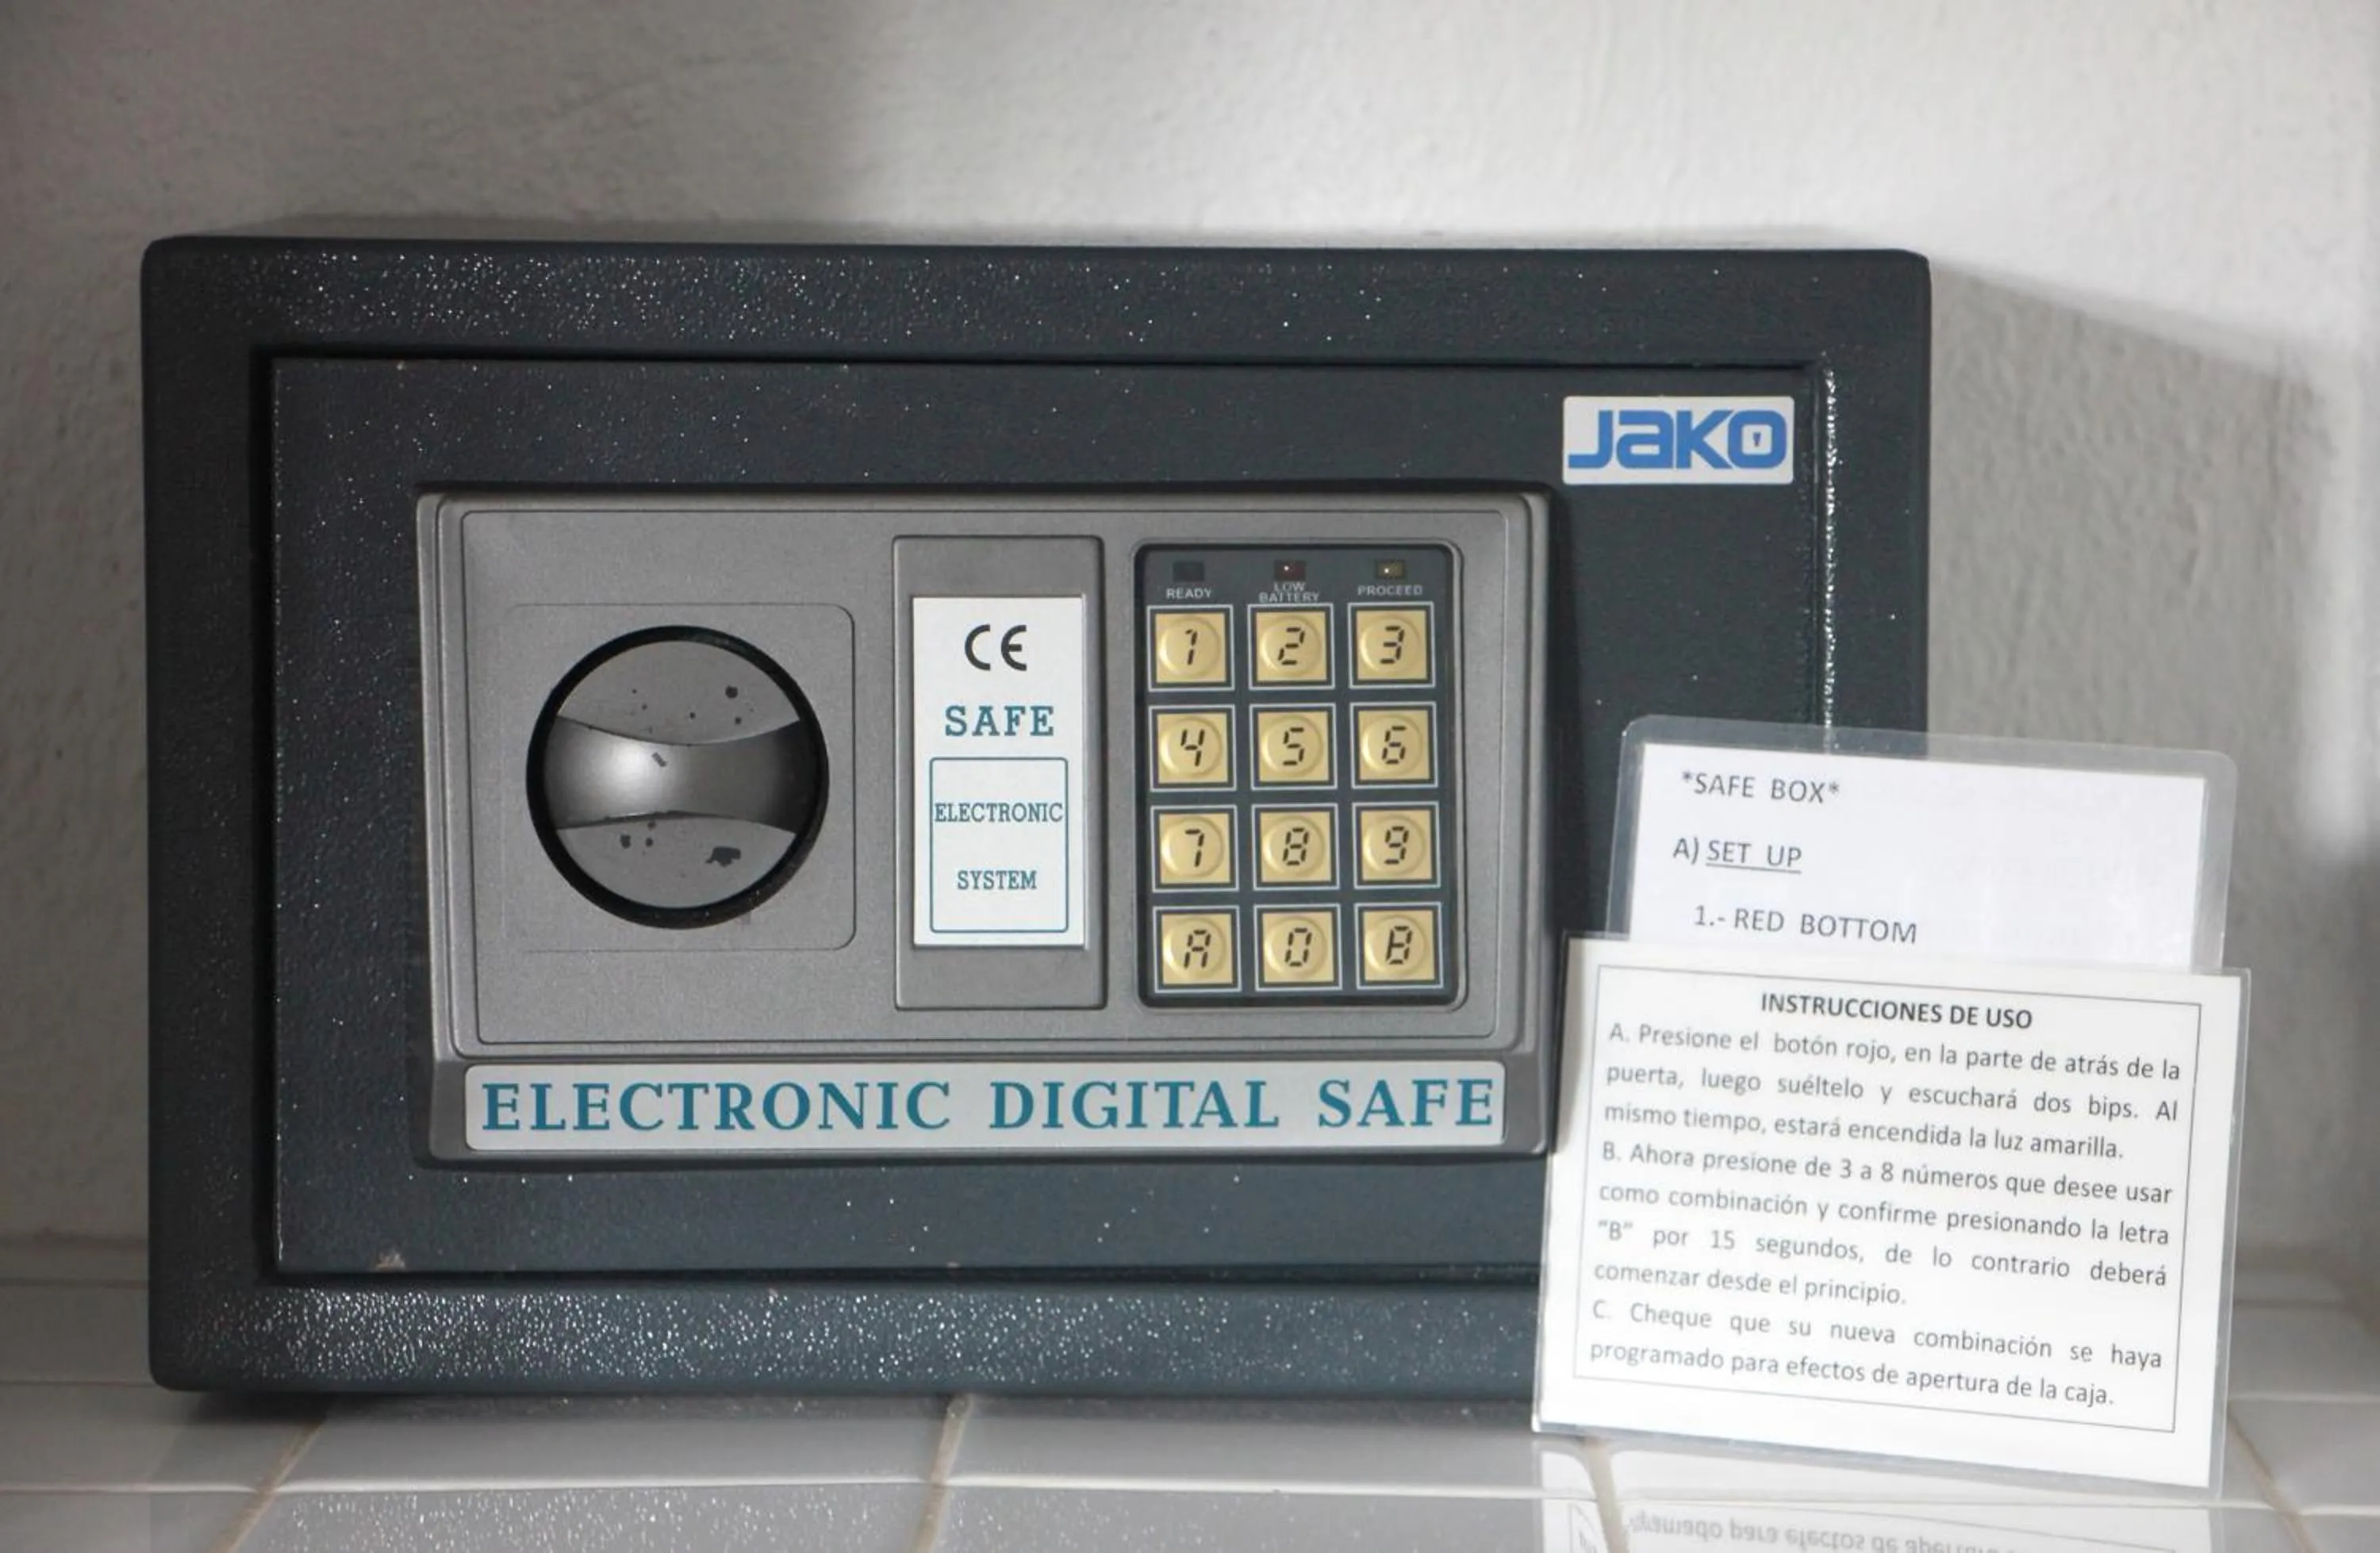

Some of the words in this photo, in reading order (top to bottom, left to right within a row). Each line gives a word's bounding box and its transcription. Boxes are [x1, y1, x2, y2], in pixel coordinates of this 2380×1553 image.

[1165, 588, 1212, 600] READY
[1258, 592, 1320, 603] BATTERY
[1273, 582, 1306, 592] LOW
[1357, 585, 1423, 596] PROCEED
[1184, 628, 1199, 666] 1
[1277, 627, 1306, 666] 2
[1379, 625, 1406, 665] 3
[944, 704, 1054, 737] SAFE
[1180, 728, 1206, 767] 4
[1281, 727, 1305, 766] 5
[1381, 725, 1407, 765] 6
[935, 802, 1063, 823] ELECTRONIC
[1184, 829, 1205, 868] 7
[1282, 827, 1310, 866] 8
[1384, 826, 1410, 865] 9
[1672, 837, 1700, 865] A)
[1706, 839, 1752, 865] SET
[1766, 845, 1802, 868] UP
[957, 869, 1038, 890] SYSTEM
[1734, 907, 1785, 933] RED
[1799, 913, 1917, 944] BOTTOM
[1760, 993, 1943, 1023] INSTRUCCIONES
[1948, 1004, 1980, 1026] DE
[1985, 1007, 2033, 1030] USO
[1609, 1022, 1630, 1041] A.
[1639, 1023, 1733, 1049] Presione
[1739, 1031, 1759, 1051] el
[1774, 1032, 1838, 1056] botón
[1846, 1040, 1896, 1064] rojo,
[1904, 1046, 1932, 1063] en
[1940, 1042, 1958, 1065] la
[1965, 1049, 2024, 1071] parte
[2030, 1049, 2057, 1072] de
[2064, 1054, 2120, 1077] atrás
[2126, 1056, 2155, 1079] de
[2162, 1057, 2181, 1081] la
[482, 1081, 950, 1131] ELECTRONIC
[988, 1079, 1280, 1129] DIGITAL
[1318, 1078, 1494, 1129] SAFE
[1606, 1066, 1684, 1089] puerta,
[1702, 1067, 1762, 1096] luego
[1777, 1075, 1864, 1099] suéltelo
[1879, 1085, 1893, 1105] y
[1908, 1085, 2017, 1110] escuchará
[2033, 1091, 2072, 1114] dos
[2088, 1094, 2139, 1122] bips.
[2155, 1099, 2178, 1122] Al
[1604, 1106, 1677, 1126] mismo
[1683, 1108, 1767, 1134] tiempo,
[1774, 1117, 1841, 1137] estará
[1847, 1122, 1962, 1147] encendida
[1969, 1126, 1987, 1149] la
[1994, 1129, 2024, 1152] luz
[2029, 1135, 2124, 1159] amarilla.
[1602, 1141, 1620, 1161] B.
[1630, 1143, 1695, 1168] Ahora
[1702, 1152, 1798, 1175] presione
[1804, 1155, 1832, 1178] de
[1840, 1158, 1852, 1179] 3
[1860, 1164, 1872, 1180] a
[1880, 1161, 1894, 1183] 8
[1902, 1164, 1998, 1191] números
[2005, 1175, 2046, 1198] que
[2053, 1173, 2118, 1200] desee
[2125, 1185, 2174, 1204] usar
[1599, 1186, 1660, 1205] como
[1668, 1190, 1808, 1216] combinación
[1817, 1202, 1829, 1222] y
[1837, 1200, 1937, 1226] confirme
[1946, 1211, 2082, 1238] presionando
[2091, 1217, 2109, 1241] la
[2119, 1220, 2169, 1245] letra
[1653, 1229, 1689, 1248] por
[1711, 1229, 1735, 1250] 15
[1756, 1237, 1864, 1263] segundos,
[1885, 1243, 1913, 1265] de
[1933, 1245, 1953, 1268] lo
[1971, 1254, 2071, 1278] contrario
[2090, 1259, 2167, 1287] deberá
[1595, 1264, 1700, 1286] comenzar
[1706, 1268, 1772, 1294] desde
[1779, 1275, 1798, 1295] el
[1804, 1279, 1906, 1306] principio.
[1630, 1302, 1712, 1330] Cheque
[1729, 1315, 1771, 1335] que
[1789, 1320, 1811, 1336] su
[1830, 1324, 1895, 1344] nueva
[1914, 1329, 2052, 1358] combinación
[2070, 1344, 2094, 1363] se
[2110, 1343, 2163, 1372] haya
[1591, 1344, 1725, 1369] programado
[1731, 1356, 1779, 1375] para
[1786, 1356, 1866, 1382] efectos
[1871, 1363, 1899, 1385] de
[1906, 1371, 1999, 1394] apertura
[2006, 1375, 2033, 1398] de
[2040, 1377, 2057, 1400] la
[2064, 1382, 2114, 1409] caja.
